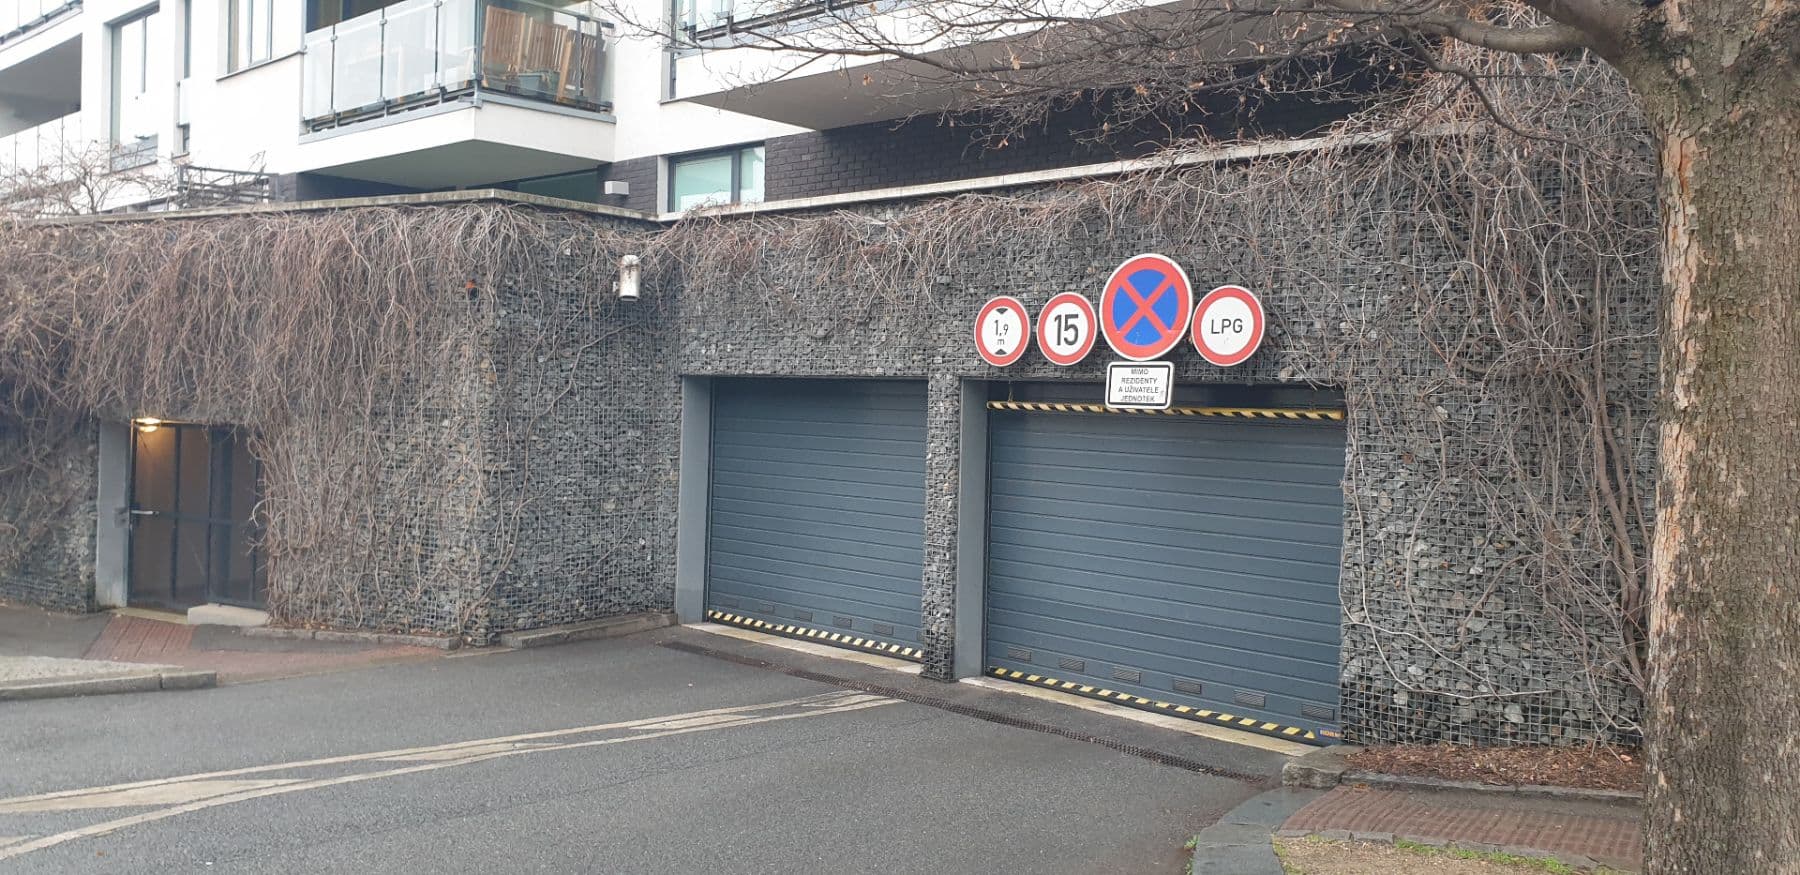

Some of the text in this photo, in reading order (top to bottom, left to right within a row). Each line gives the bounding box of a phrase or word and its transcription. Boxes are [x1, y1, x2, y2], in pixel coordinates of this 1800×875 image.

[994, 319, 1008, 336] 1,9
[1054, 313, 1078, 346] 15
[1211, 318, 1243, 334] LPG
[1125, 385, 1159, 394] UŽIVATELE
